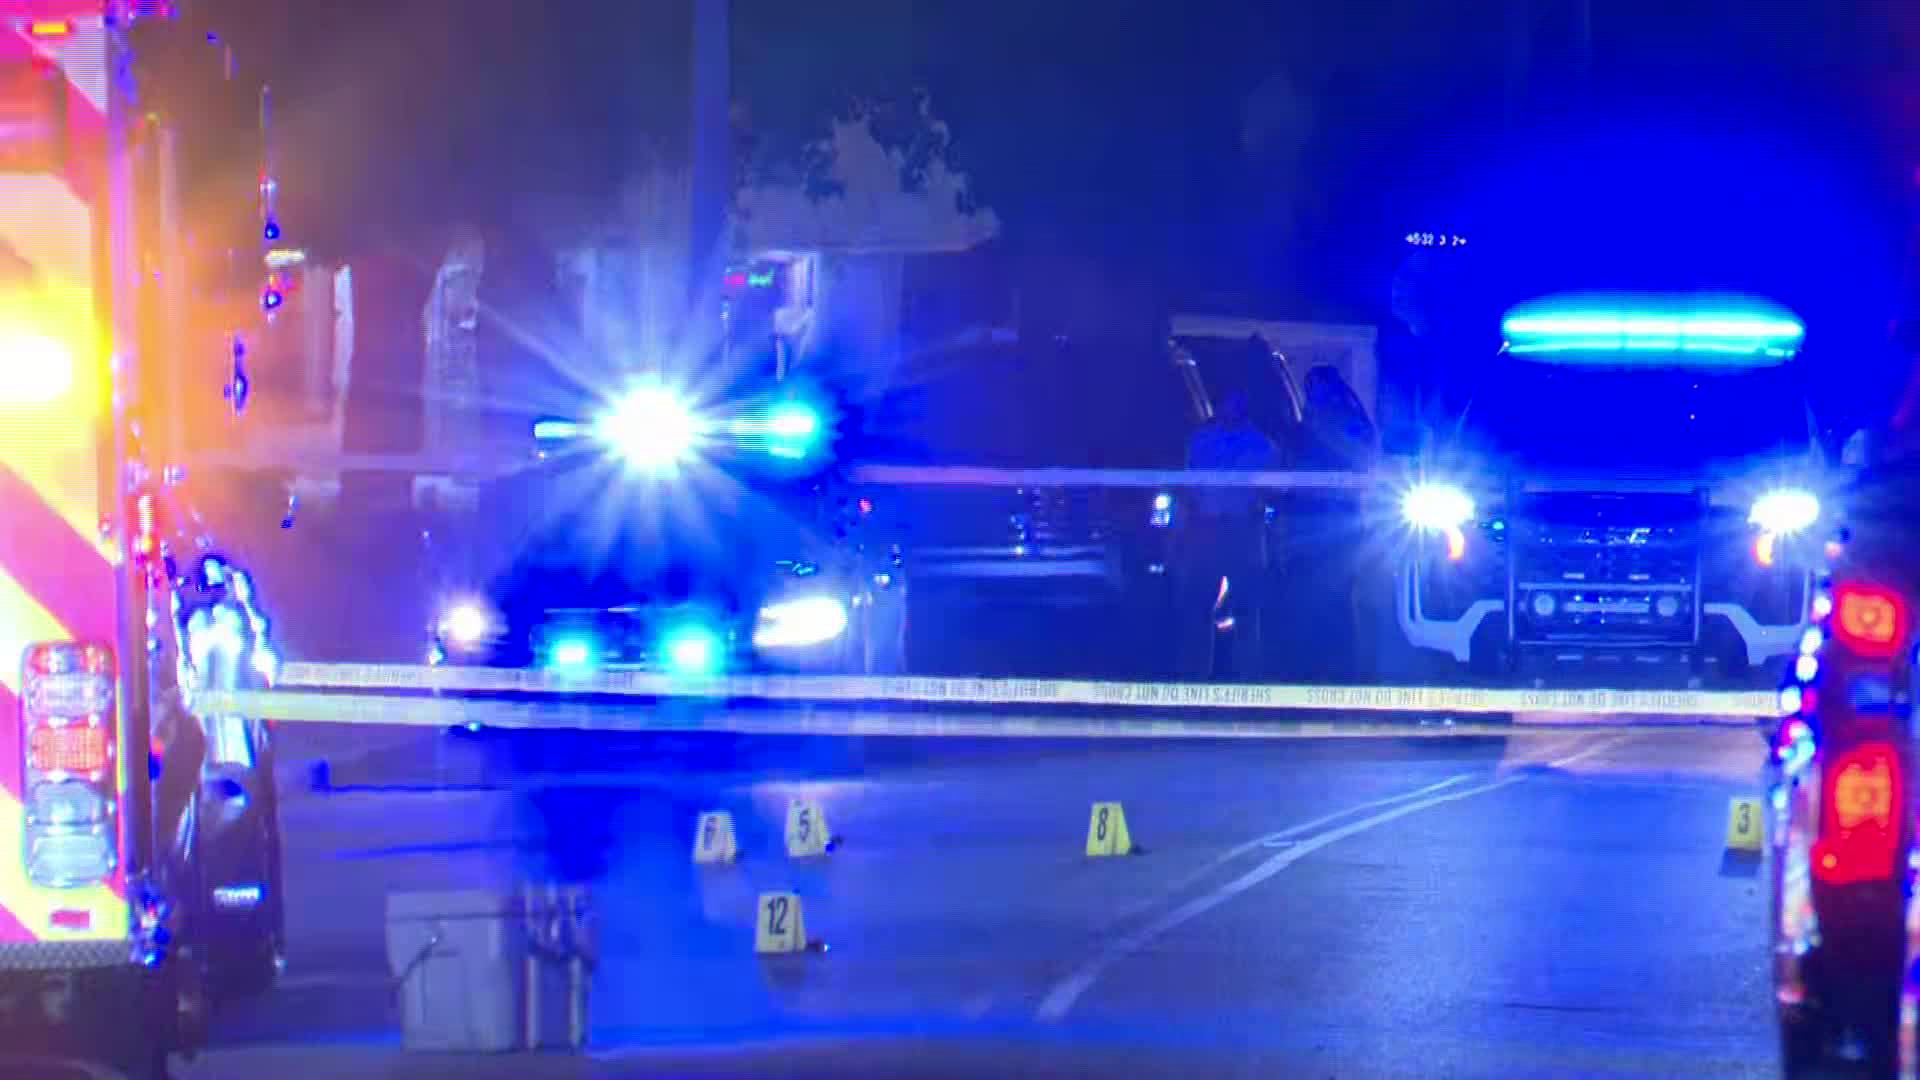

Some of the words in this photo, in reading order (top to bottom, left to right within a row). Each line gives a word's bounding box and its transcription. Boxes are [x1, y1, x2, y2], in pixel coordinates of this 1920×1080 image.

[799, 809, 811, 843] 5
[1097, 807, 1109, 841] 8
[1737, 802, 1750, 834] 3
[767, 896, 789, 935] 12
